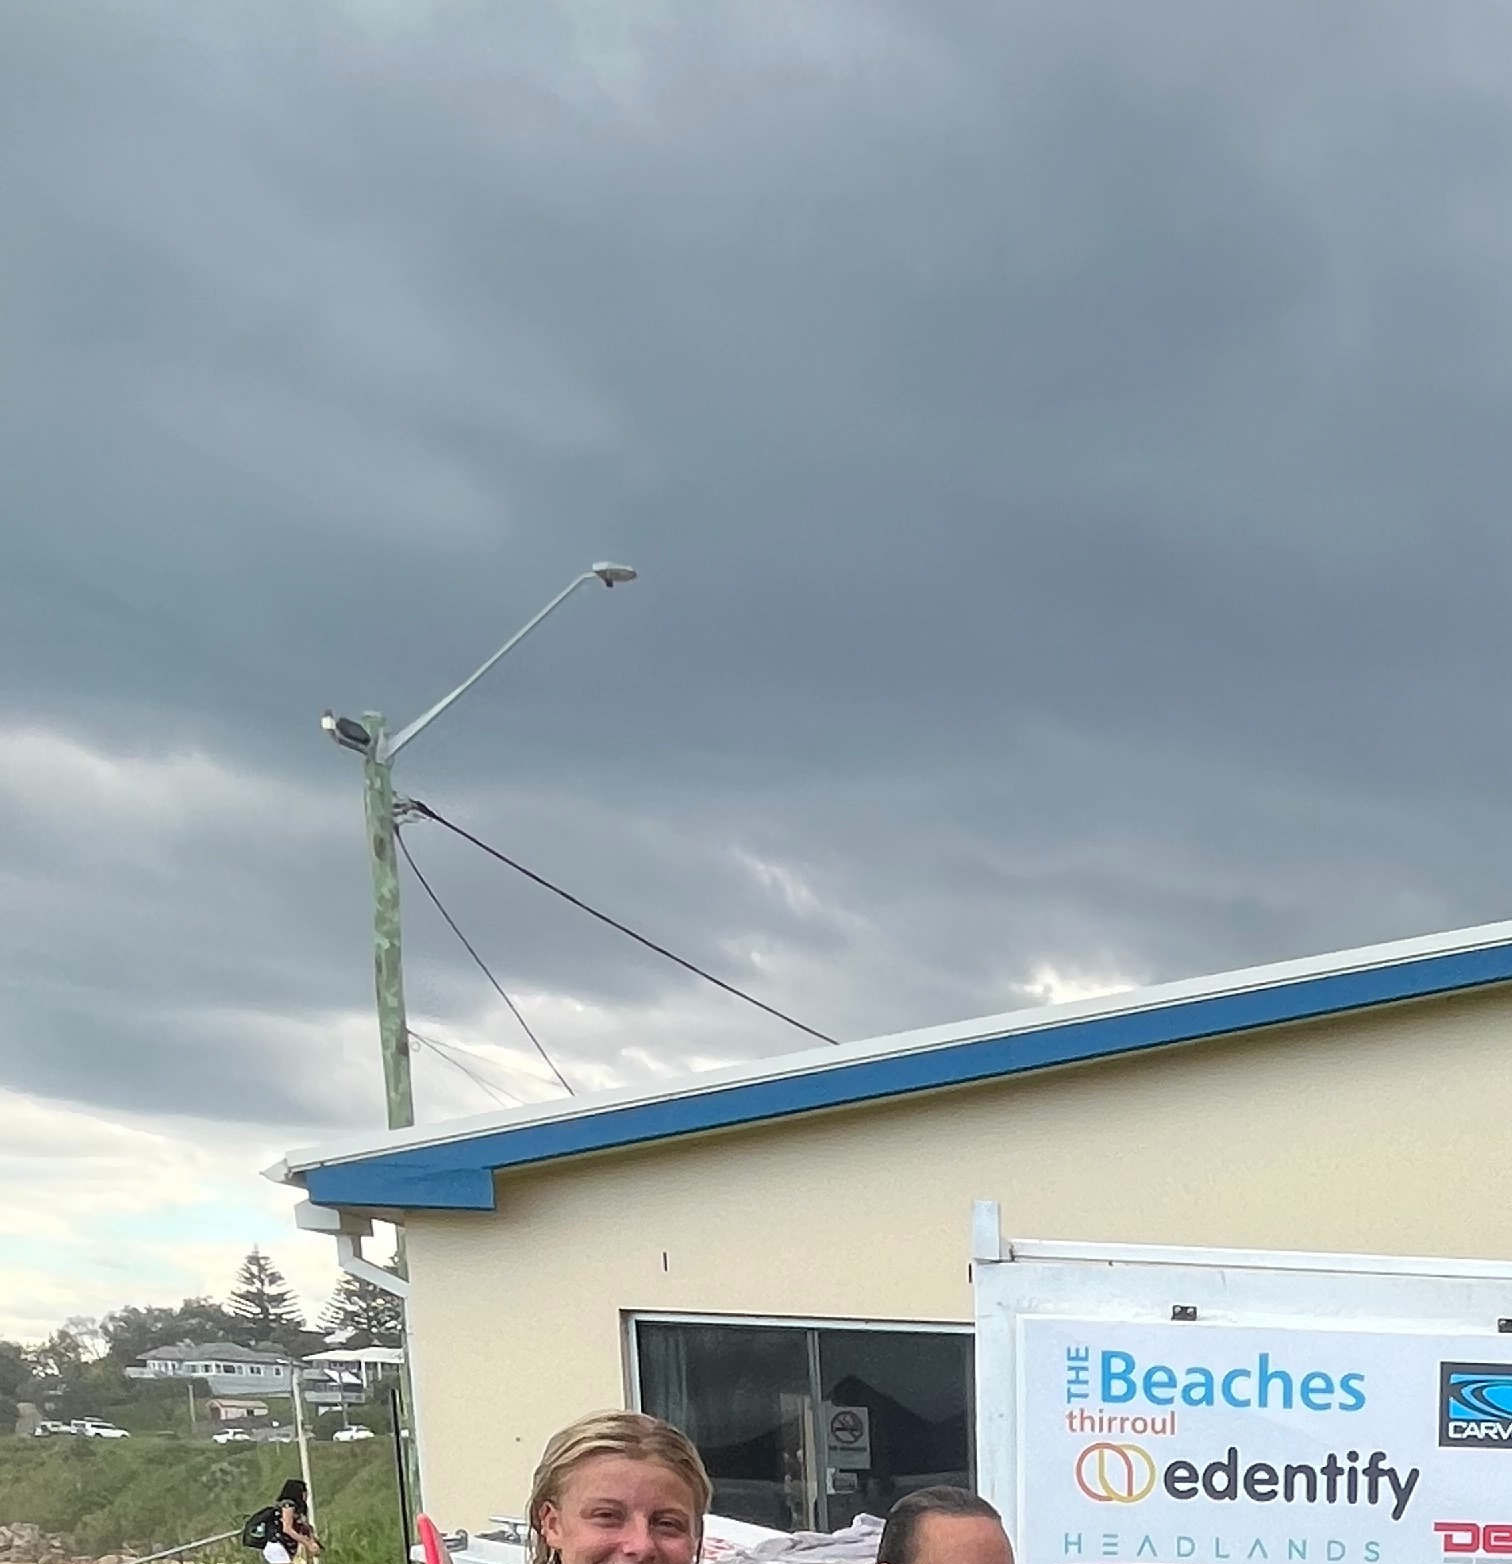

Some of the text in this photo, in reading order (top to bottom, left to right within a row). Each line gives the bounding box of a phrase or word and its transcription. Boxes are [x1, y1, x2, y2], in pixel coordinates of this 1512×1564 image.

[1066, 1345, 1089, 1403] THE
[1101, 1349, 1367, 1411] Beaches
[1066, 1407, 1177, 1436] thirroul
[1163, 1447, 1420, 1521] edentify
[1064, 1532, 1382, 1562] HEADLANDS
